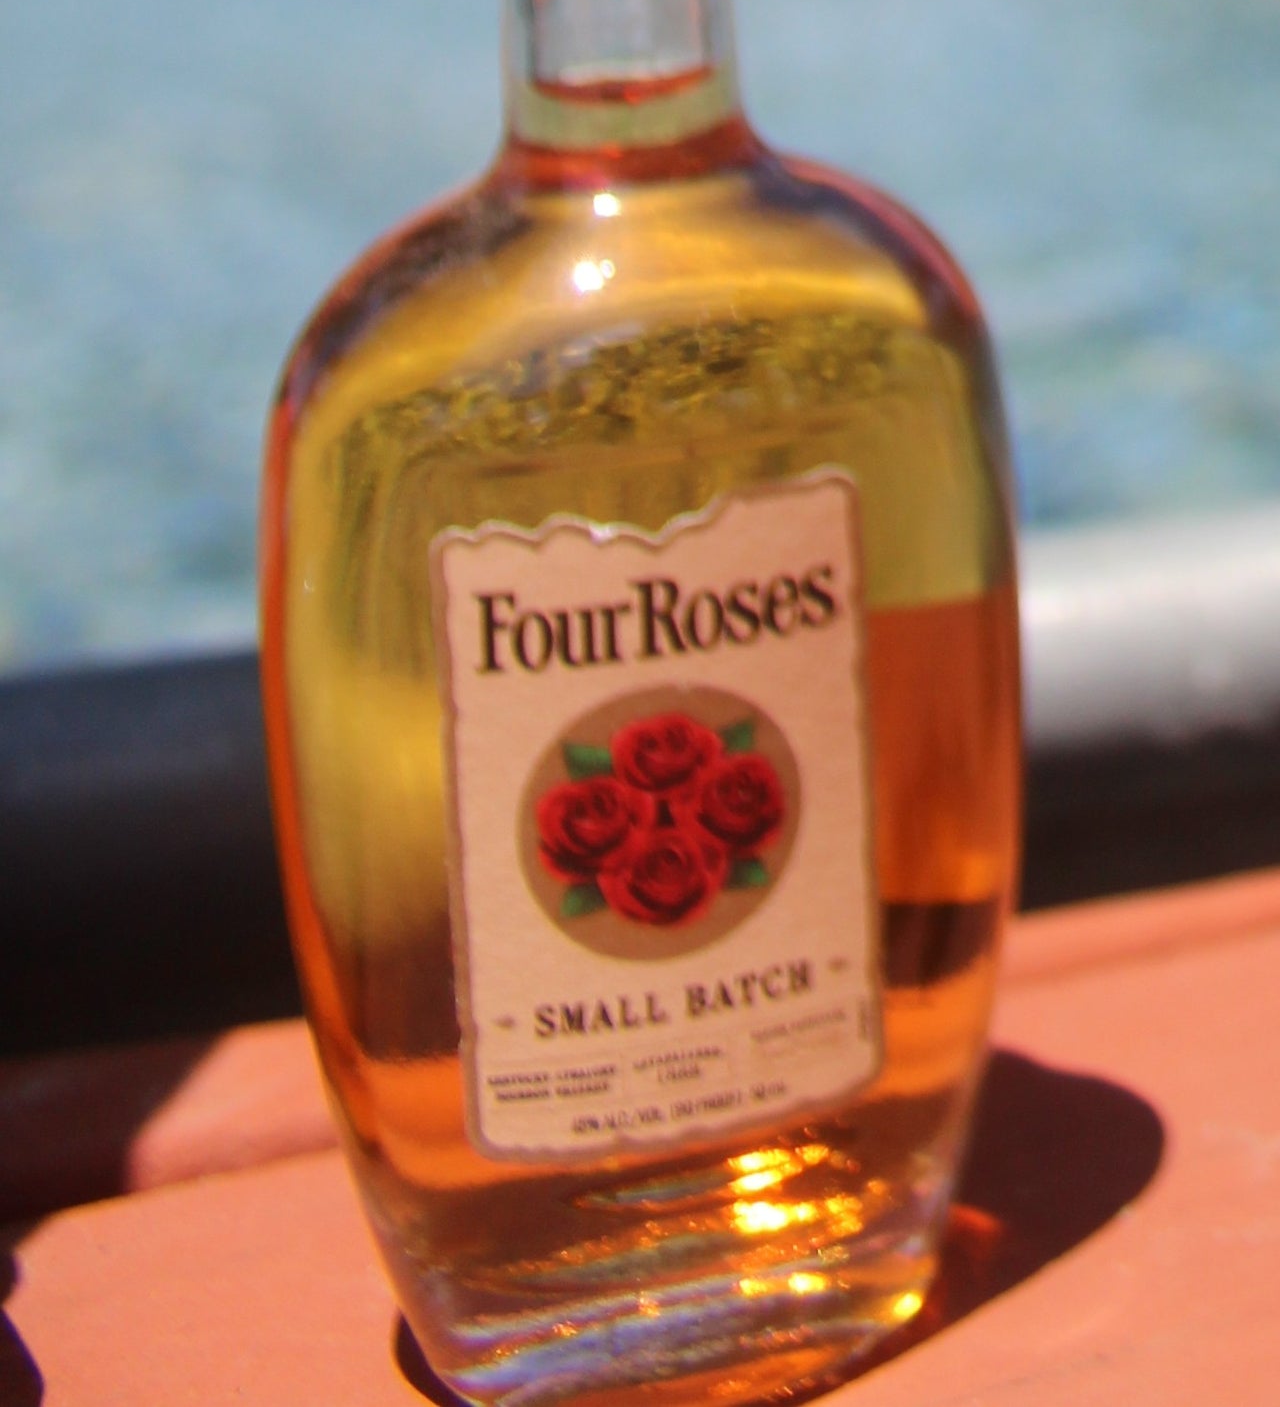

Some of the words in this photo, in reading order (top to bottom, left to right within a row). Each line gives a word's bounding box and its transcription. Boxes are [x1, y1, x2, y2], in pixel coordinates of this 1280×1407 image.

[474, 590, 631, 674] Four
[630, 564, 837, 661] Roses
[533, 990, 668, 1039] SMALL
[685, 958, 816, 1019] BATCH
